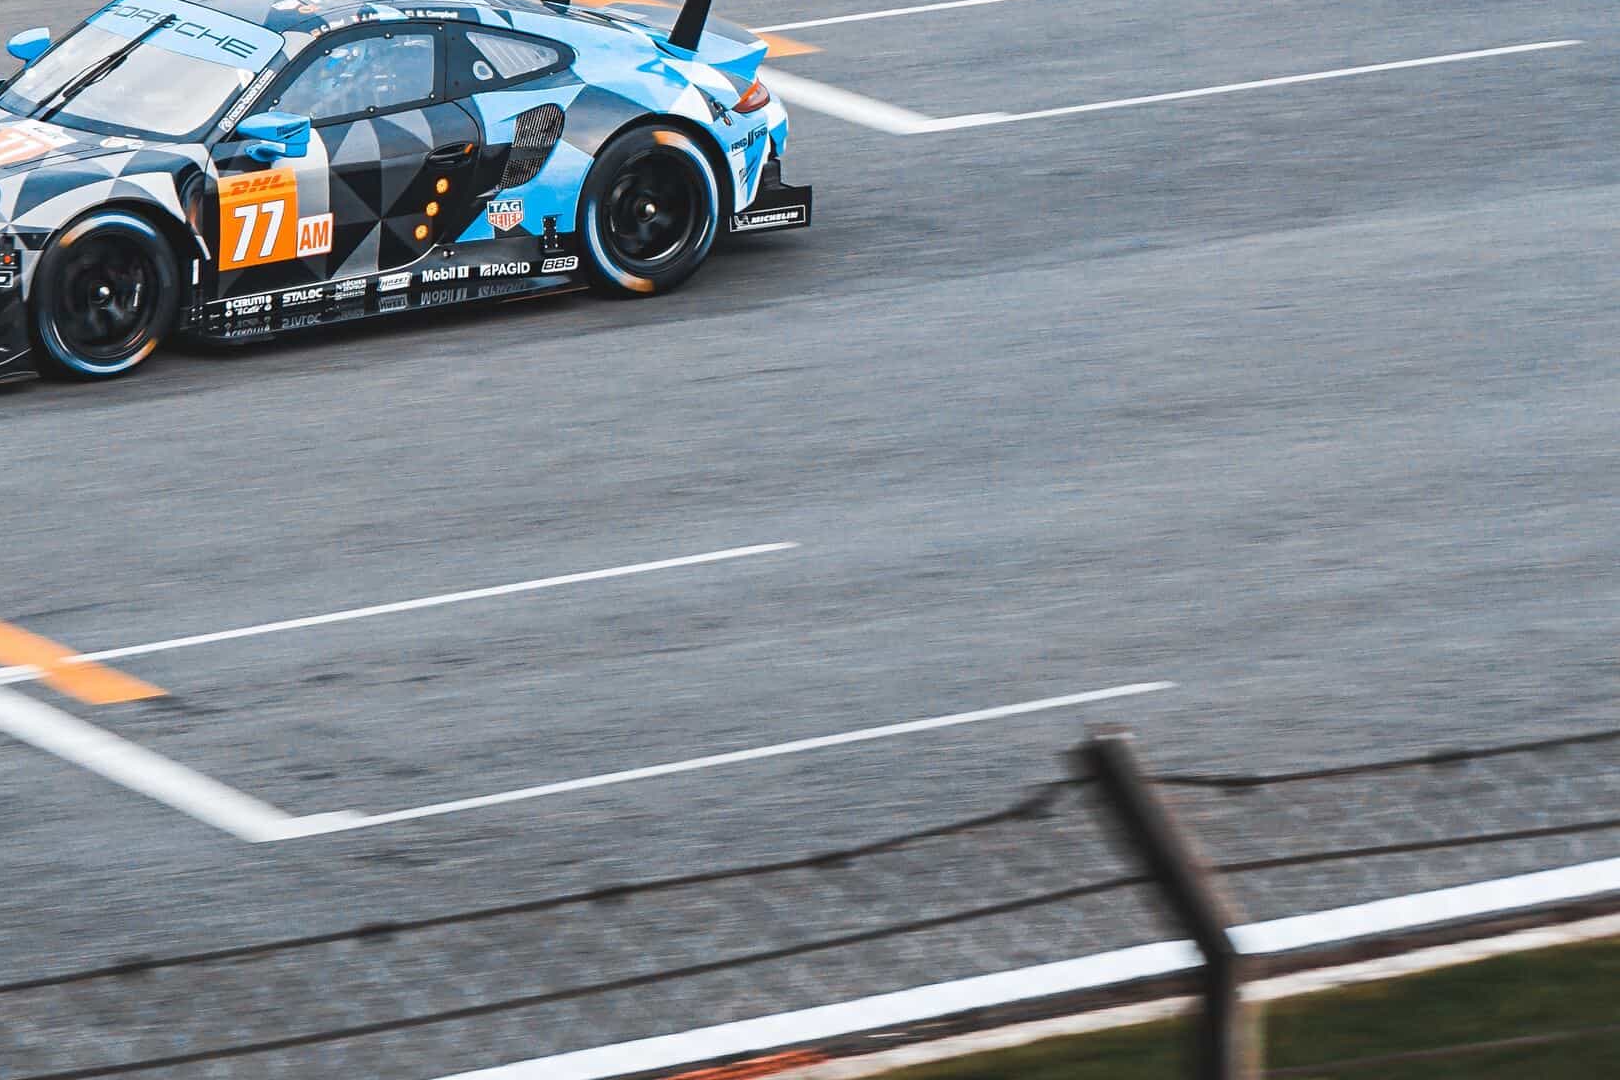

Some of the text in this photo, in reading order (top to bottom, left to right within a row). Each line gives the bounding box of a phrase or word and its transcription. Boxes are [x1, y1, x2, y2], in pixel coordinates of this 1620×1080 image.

[229, 173, 285, 196] DHL
[490, 202, 520, 213] TAG
[489, 213, 522, 228] HEUER
[751, 211, 799, 224] MICHELIN
[232, 199, 285, 262] 77
[299, 220, 329, 250] AM
[422, 266, 456, 283] Mobil
[491, 262, 530, 276] PAGID
[282, 288, 323, 305] STALOC
